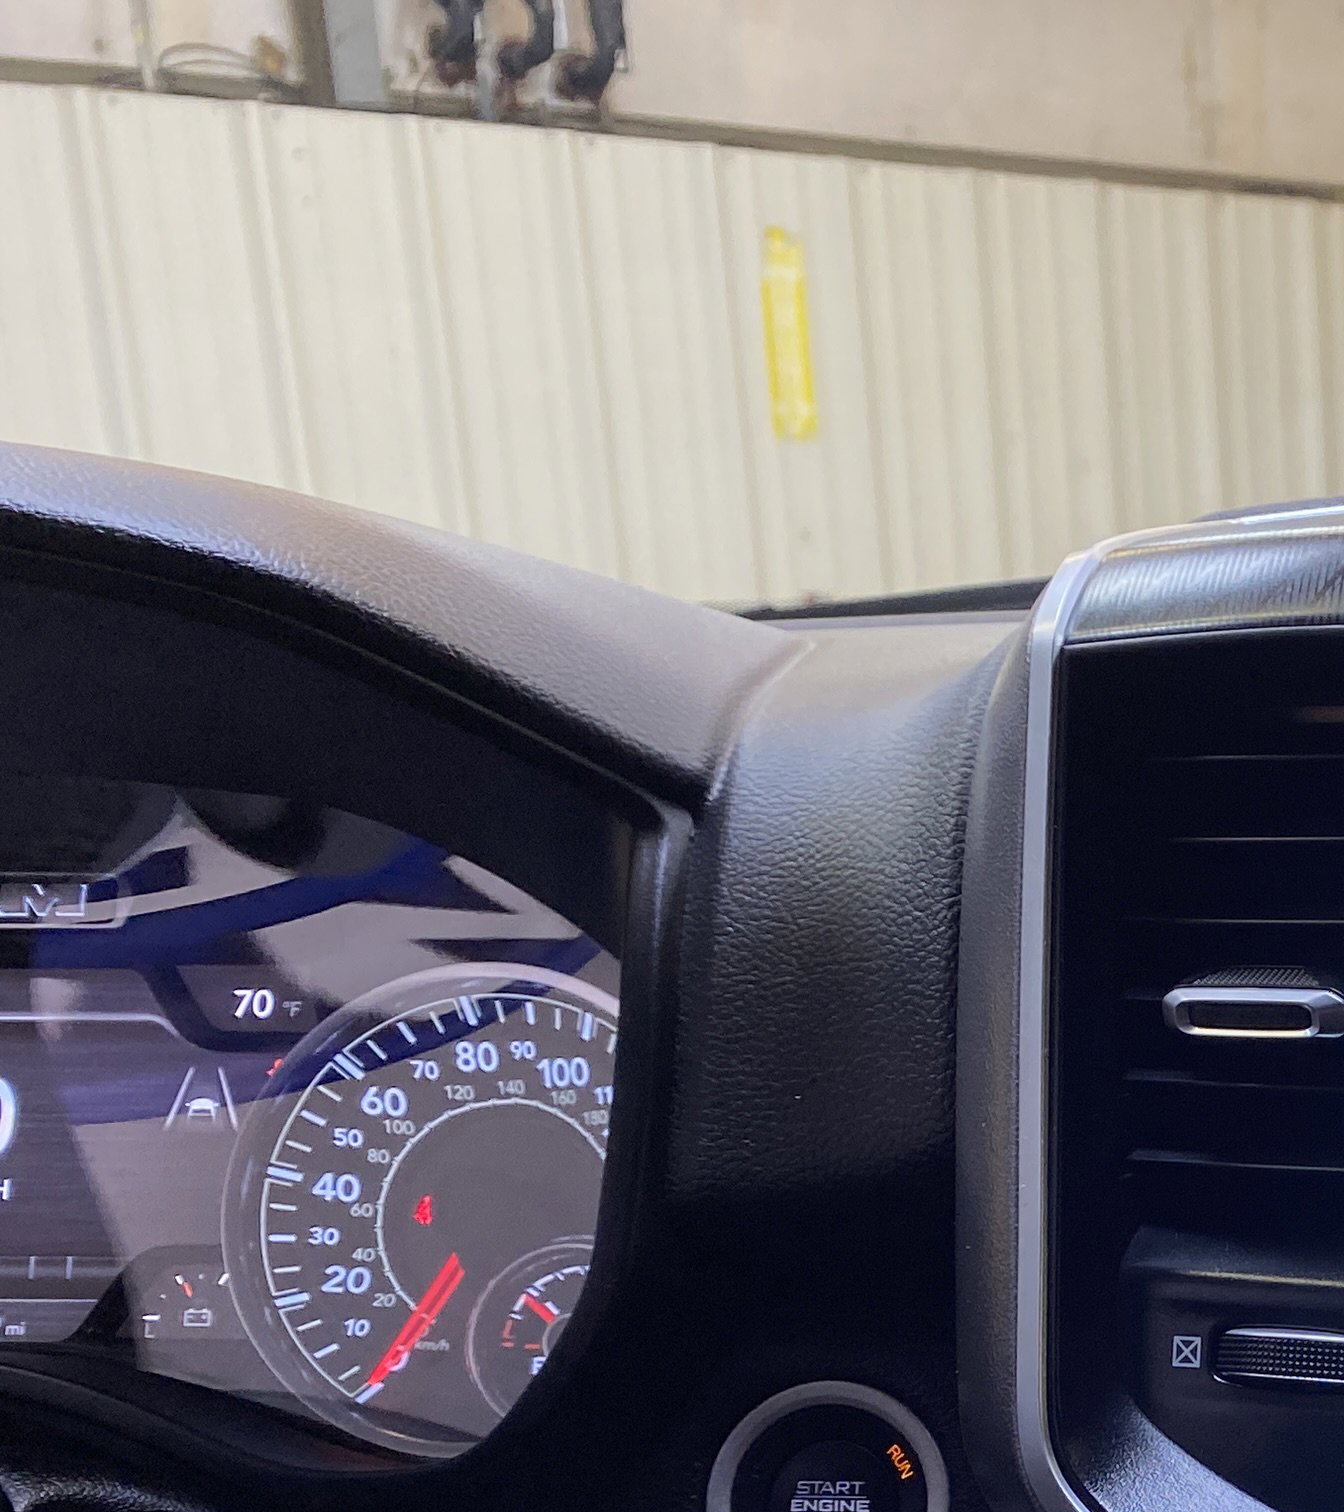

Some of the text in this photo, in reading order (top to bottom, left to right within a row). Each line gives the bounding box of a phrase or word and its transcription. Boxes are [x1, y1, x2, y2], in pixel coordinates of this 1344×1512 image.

[233, 988, 275, 1019] 70
[455, 1039, 500, 1072] 80
[509, 1040, 537, 1061] 90
[409, 1058, 440, 1081] 70
[535, 1056, 591, 1088] 100
[443, 1084, 475, 1102] 120
[496, 1079, 526, 1095] 140
[594, 1085, 613, 1104] 11
[360, 1085, 408, 1117] 60
[382, 1118, 416, 1136] 100
[332, 1127, 364, 1148] 50
[366, 1148, 392, 1164] 80
[311, 1172, 361, 1203] 40
[349, 1201, 375, 1218] 60
[307, 1224, 340, 1246] 30
[351, 1247, 377, 1262] 40
[320, 1263, 372, 1294] 20
[371, 1292, 397, 1308] 20
[343, 1318, 371, 1338] 10
[886, 1444, 914, 1480] RUN
[796, 1480, 865, 1495] START
[790, 1498, 871, 1512] ENGINE
